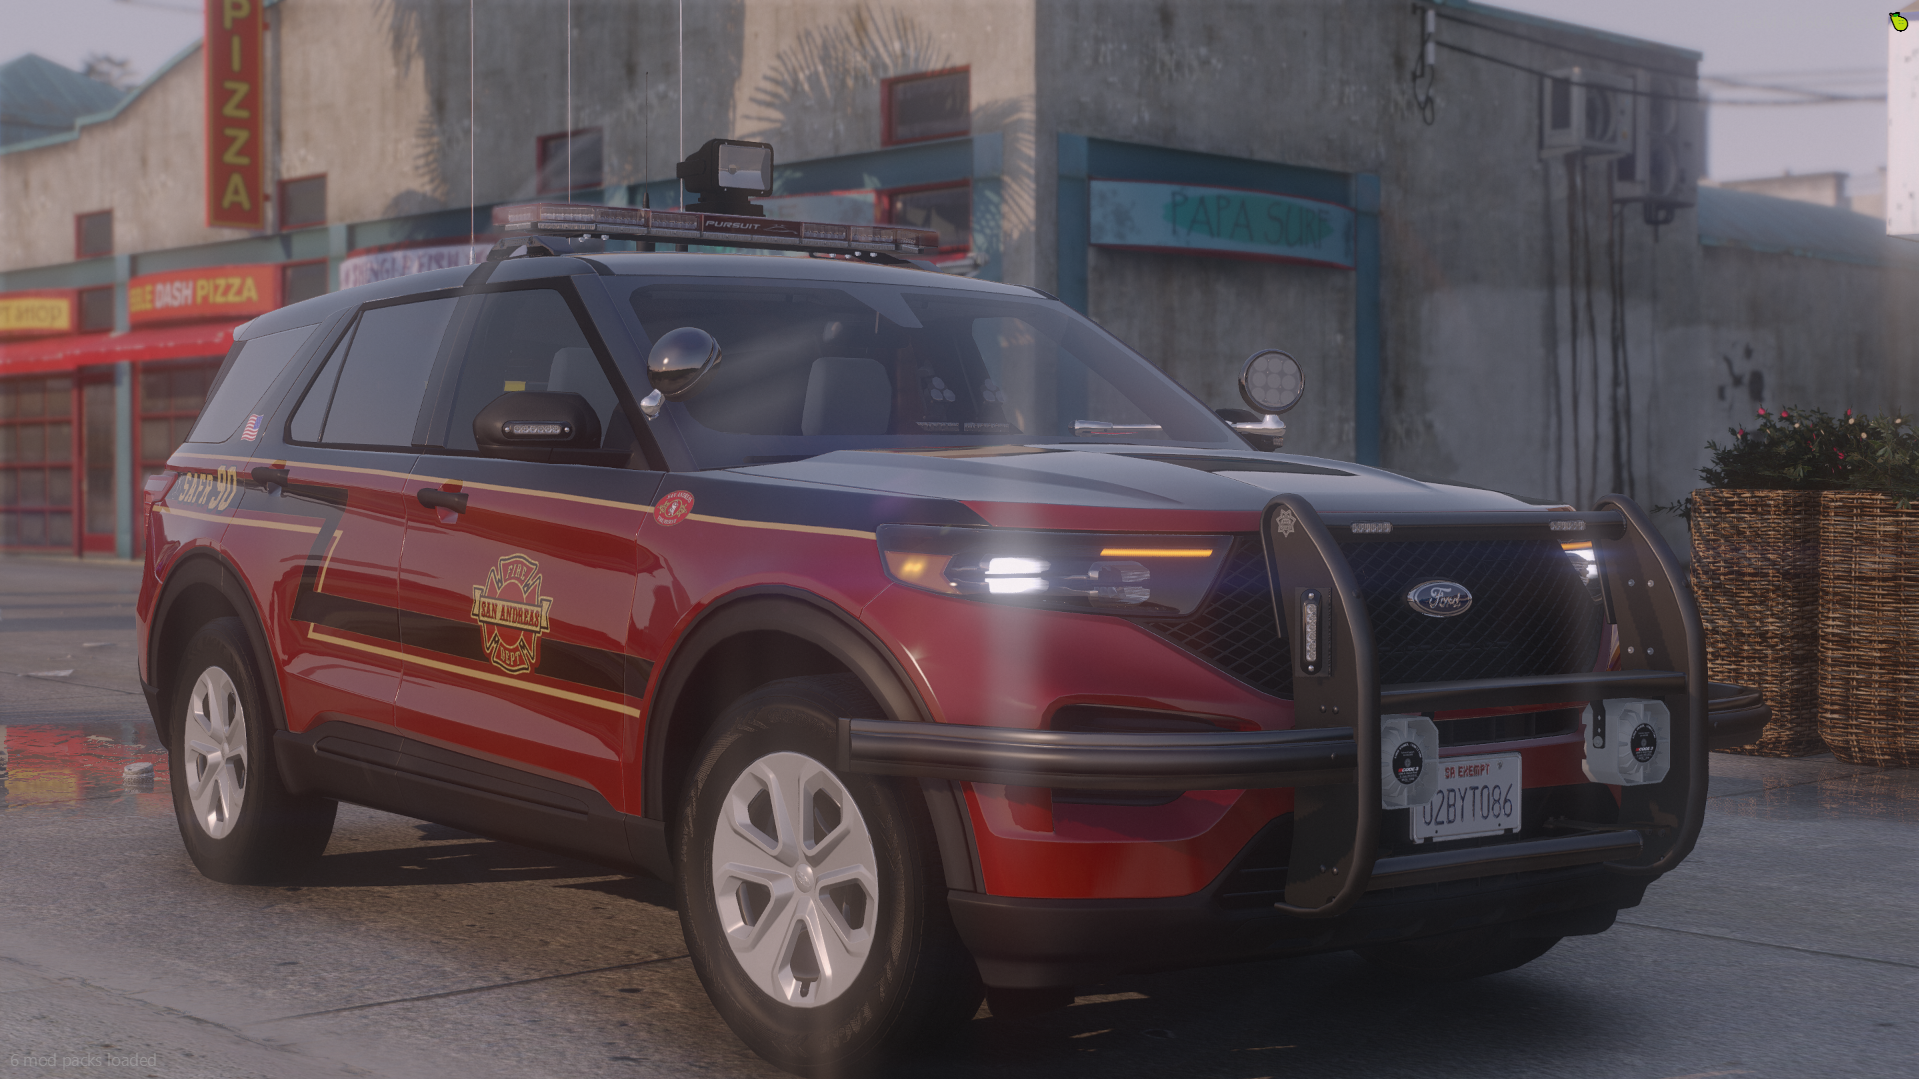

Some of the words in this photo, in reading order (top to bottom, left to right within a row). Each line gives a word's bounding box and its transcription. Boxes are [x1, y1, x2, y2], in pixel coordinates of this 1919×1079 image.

[222, 0, 251, 211] PIZZA
[705, 220, 761, 230] PURSUIT
[1171, 191, 1255, 242] PAPA
[1263, 201, 1330, 250] SURF
[154, 280, 195, 310] DASH
[195, 276, 259, 306] PIZZA
[179, 471, 214, 505] SAFR
[208, 464, 238, 511] 90
[505, 563, 527, 582] FIRE
[481, 601, 498, 620] SAN
[500, 603, 540, 628] ANDREAS
[500, 646, 521, 666] DEPT
[1444, 766, 1455, 779] SA
[1457, 763, 1490, 778] EXEMPT
